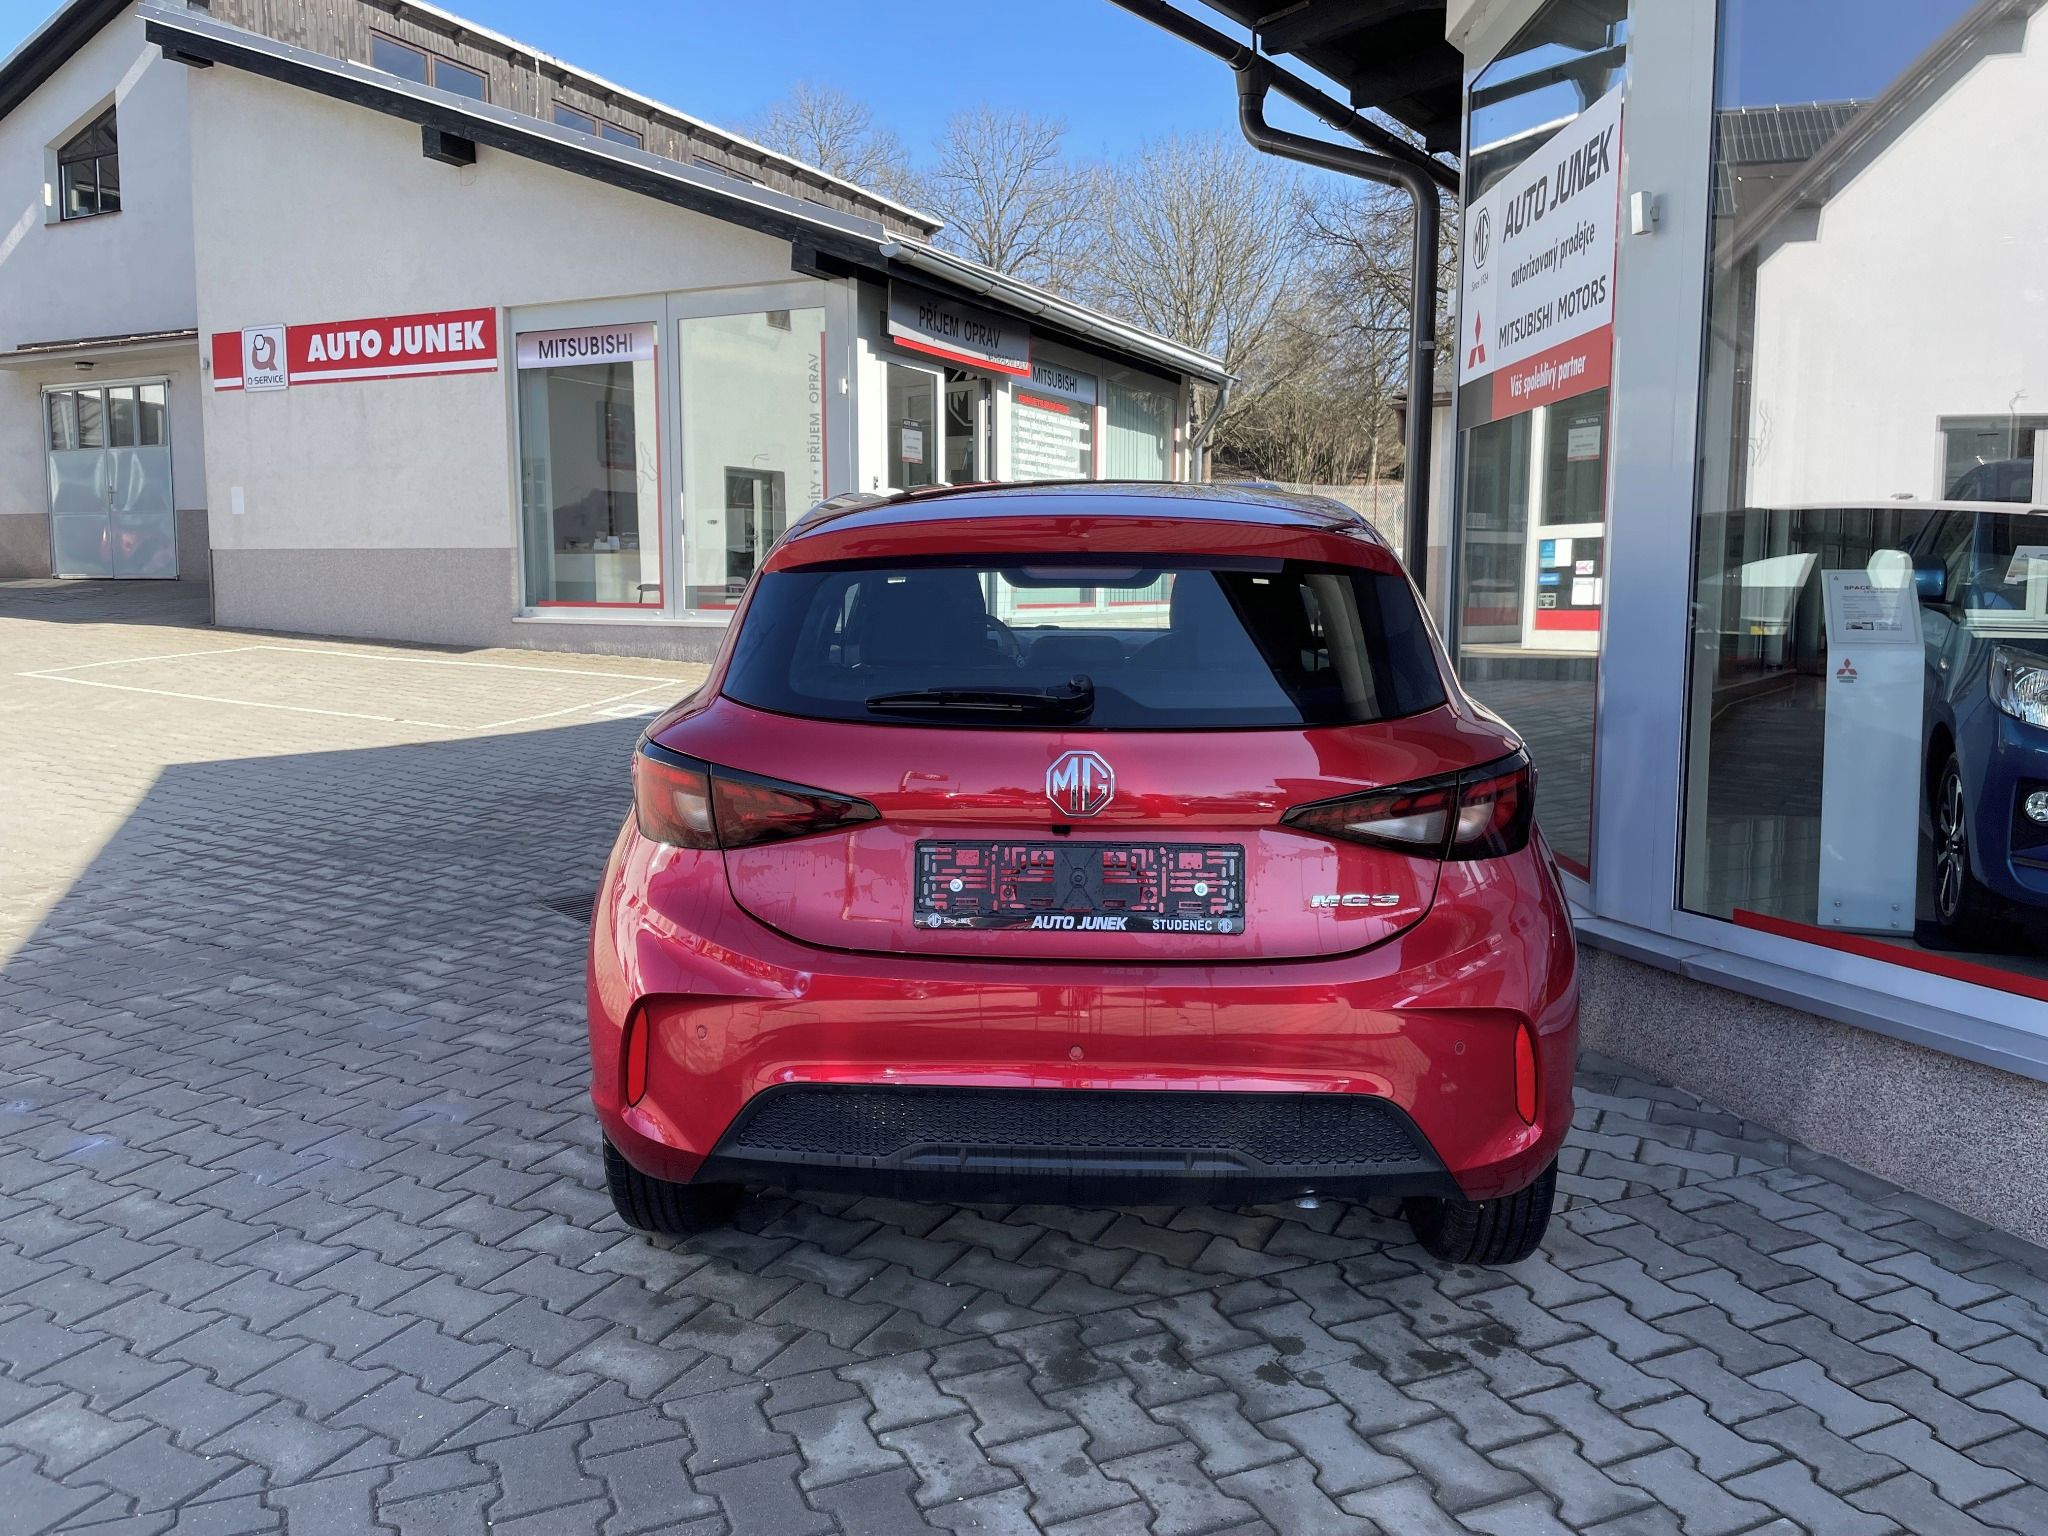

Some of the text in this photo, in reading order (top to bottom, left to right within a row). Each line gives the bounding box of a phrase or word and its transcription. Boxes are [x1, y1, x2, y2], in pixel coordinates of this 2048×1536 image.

[1502, 123, 1614, 244] AUTO JUNEK
[1473, 207, 1490, 269] MG
[1511, 222, 1595, 289] autorizovaný prodejce
[918, 302, 1001, 349] PŘÍJEM OPRAV
[1498, 274, 1606, 351] MITSUBISHI MOTORS
[307, 319, 486, 363] AUTO JUNEK
[537, 332, 634, 360] MITSUBISHI
[807, 353, 820, 404] OPRAV
[1032, 367, 1077, 393] MITSUBISHI
[1510, 354, 1587, 401] Váš spolehlivý partner
[807, 412, 820, 463] PŘÍJEM
[1046, 749, 1115, 818] MG
[1031, 915, 1129, 931] AUTO JUNEK
[1310, 893, 1400, 908] MG3
[1152, 919, 1213, 931] STUDENEC
